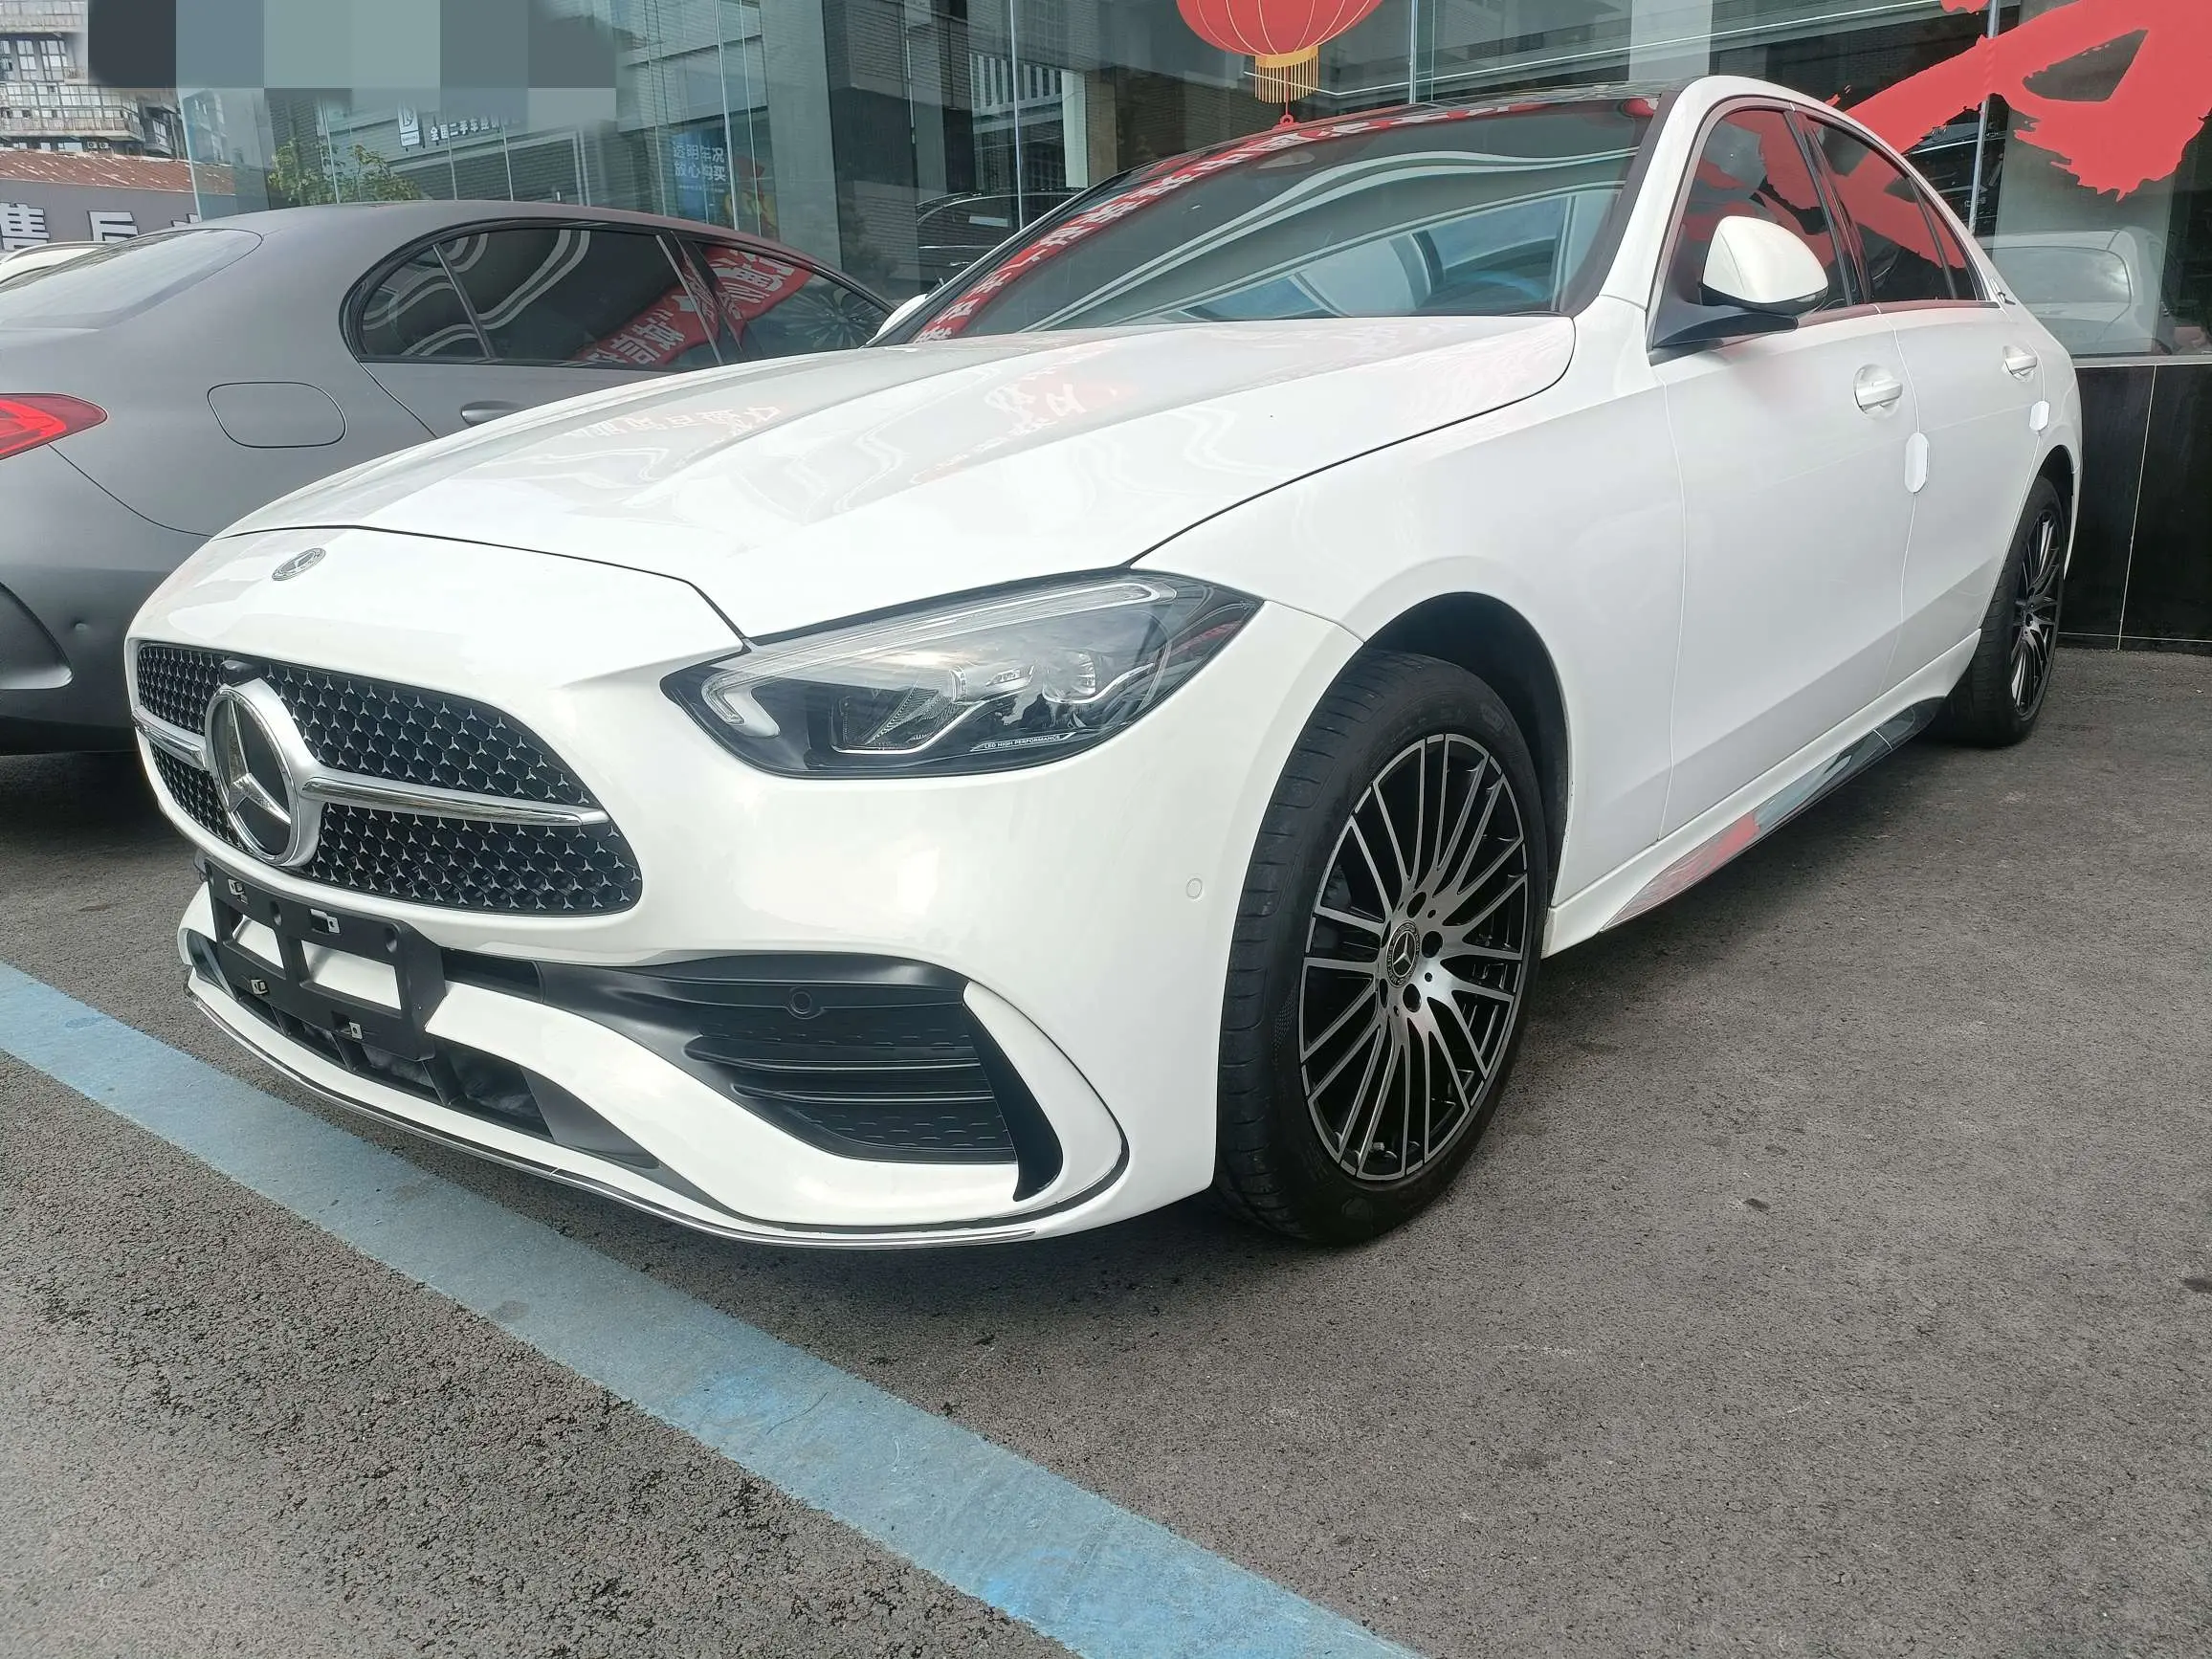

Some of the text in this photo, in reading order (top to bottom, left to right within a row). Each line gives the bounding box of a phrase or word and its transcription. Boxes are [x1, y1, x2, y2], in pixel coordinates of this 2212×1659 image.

[673, 141, 725, 163] 透明车况
[674, 160, 726, 182] 放心购买
[1014, 736, 1060, 744] PERFORMANCE
